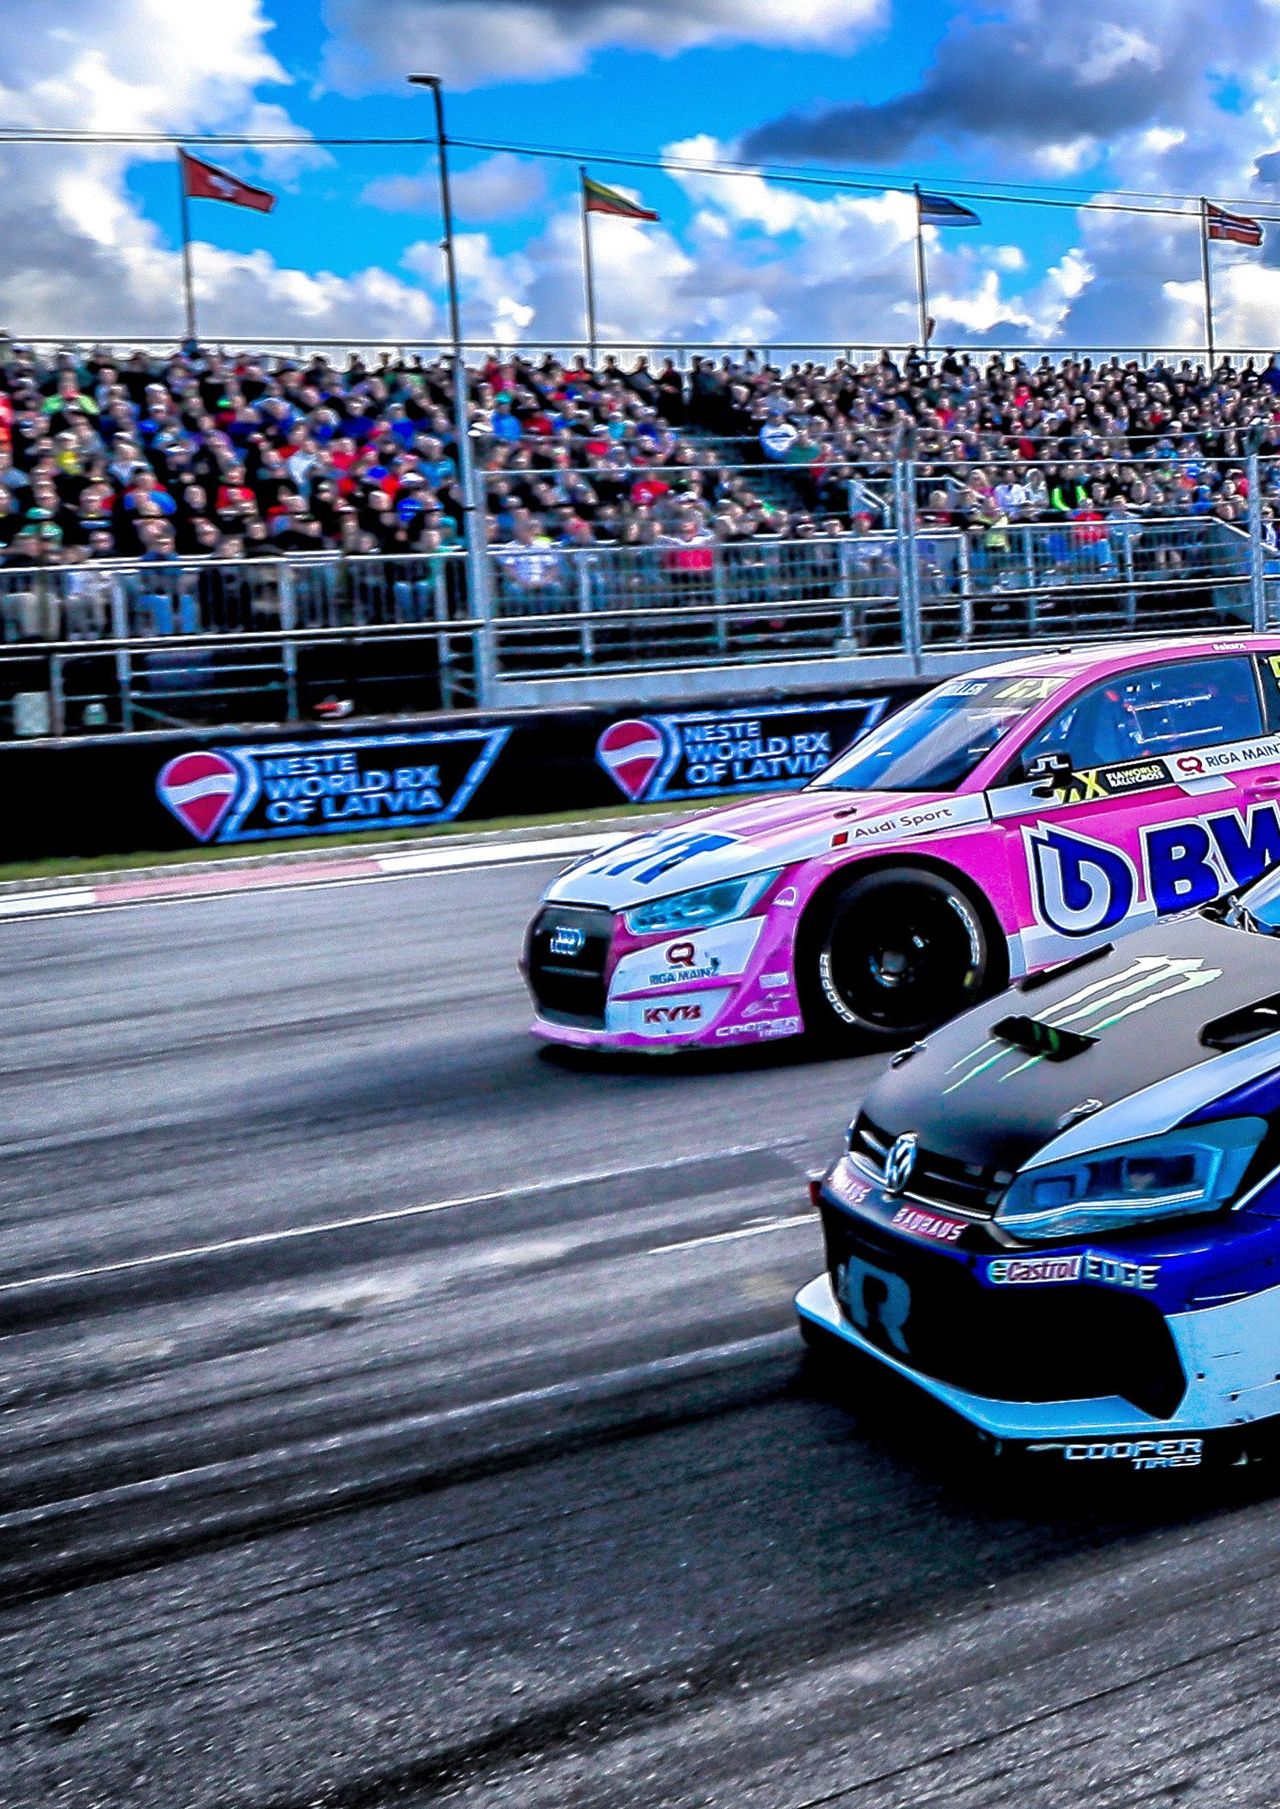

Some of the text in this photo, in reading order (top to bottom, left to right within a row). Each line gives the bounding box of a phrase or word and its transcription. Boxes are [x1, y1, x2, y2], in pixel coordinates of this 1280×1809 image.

[683, 720, 761, 743] NESTE
[684, 731, 831, 764] WORLD RX
[1205, 752, 1240, 768] RIGA
[262, 751, 357, 777] NESTE
[685, 754, 830, 785] OF LATVIA
[263, 765, 442, 800] WORLD RX
[1110, 773, 1165, 788] RALLYCROSS
[265, 788, 443, 824] OF LATVIA
[853, 806, 953, 841] Audi Sport
[649, 973, 676, 986] RIGA
[818, 953, 856, 1023] COOPER
[644, 1004, 702, 1024] KYB
[892, 1207, 969, 1241] BAUHAUS
[1006, 1250, 1161, 1290] Castrol EDGE
[838, 1254, 912, 1355] R
[1063, 1439, 1203, 1461] COOPER
[1131, 1456, 1203, 1470] TIRES
